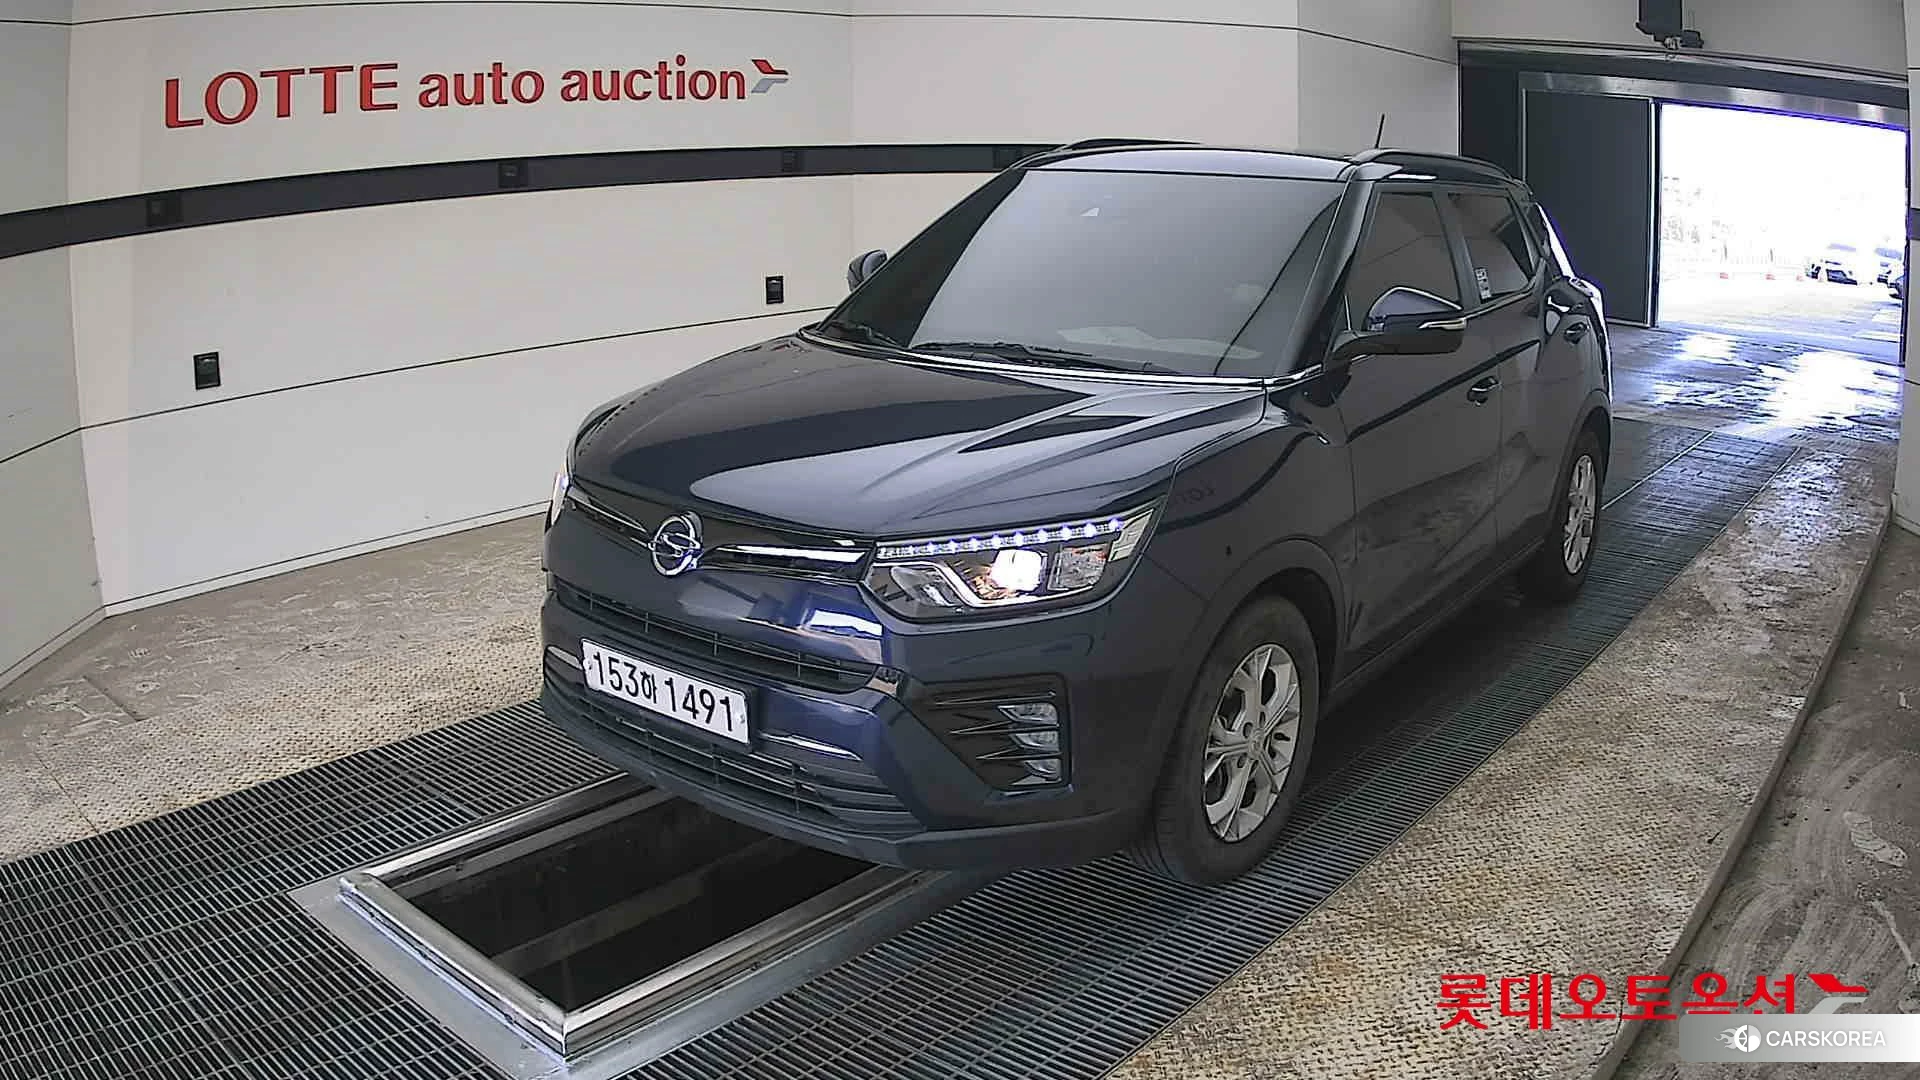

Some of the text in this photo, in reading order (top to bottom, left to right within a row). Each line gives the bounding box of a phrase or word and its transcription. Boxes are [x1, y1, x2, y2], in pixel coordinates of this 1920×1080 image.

[165, 55, 746, 129] LOTTE auto auction
[593, 651, 732, 732] 153하 1491
